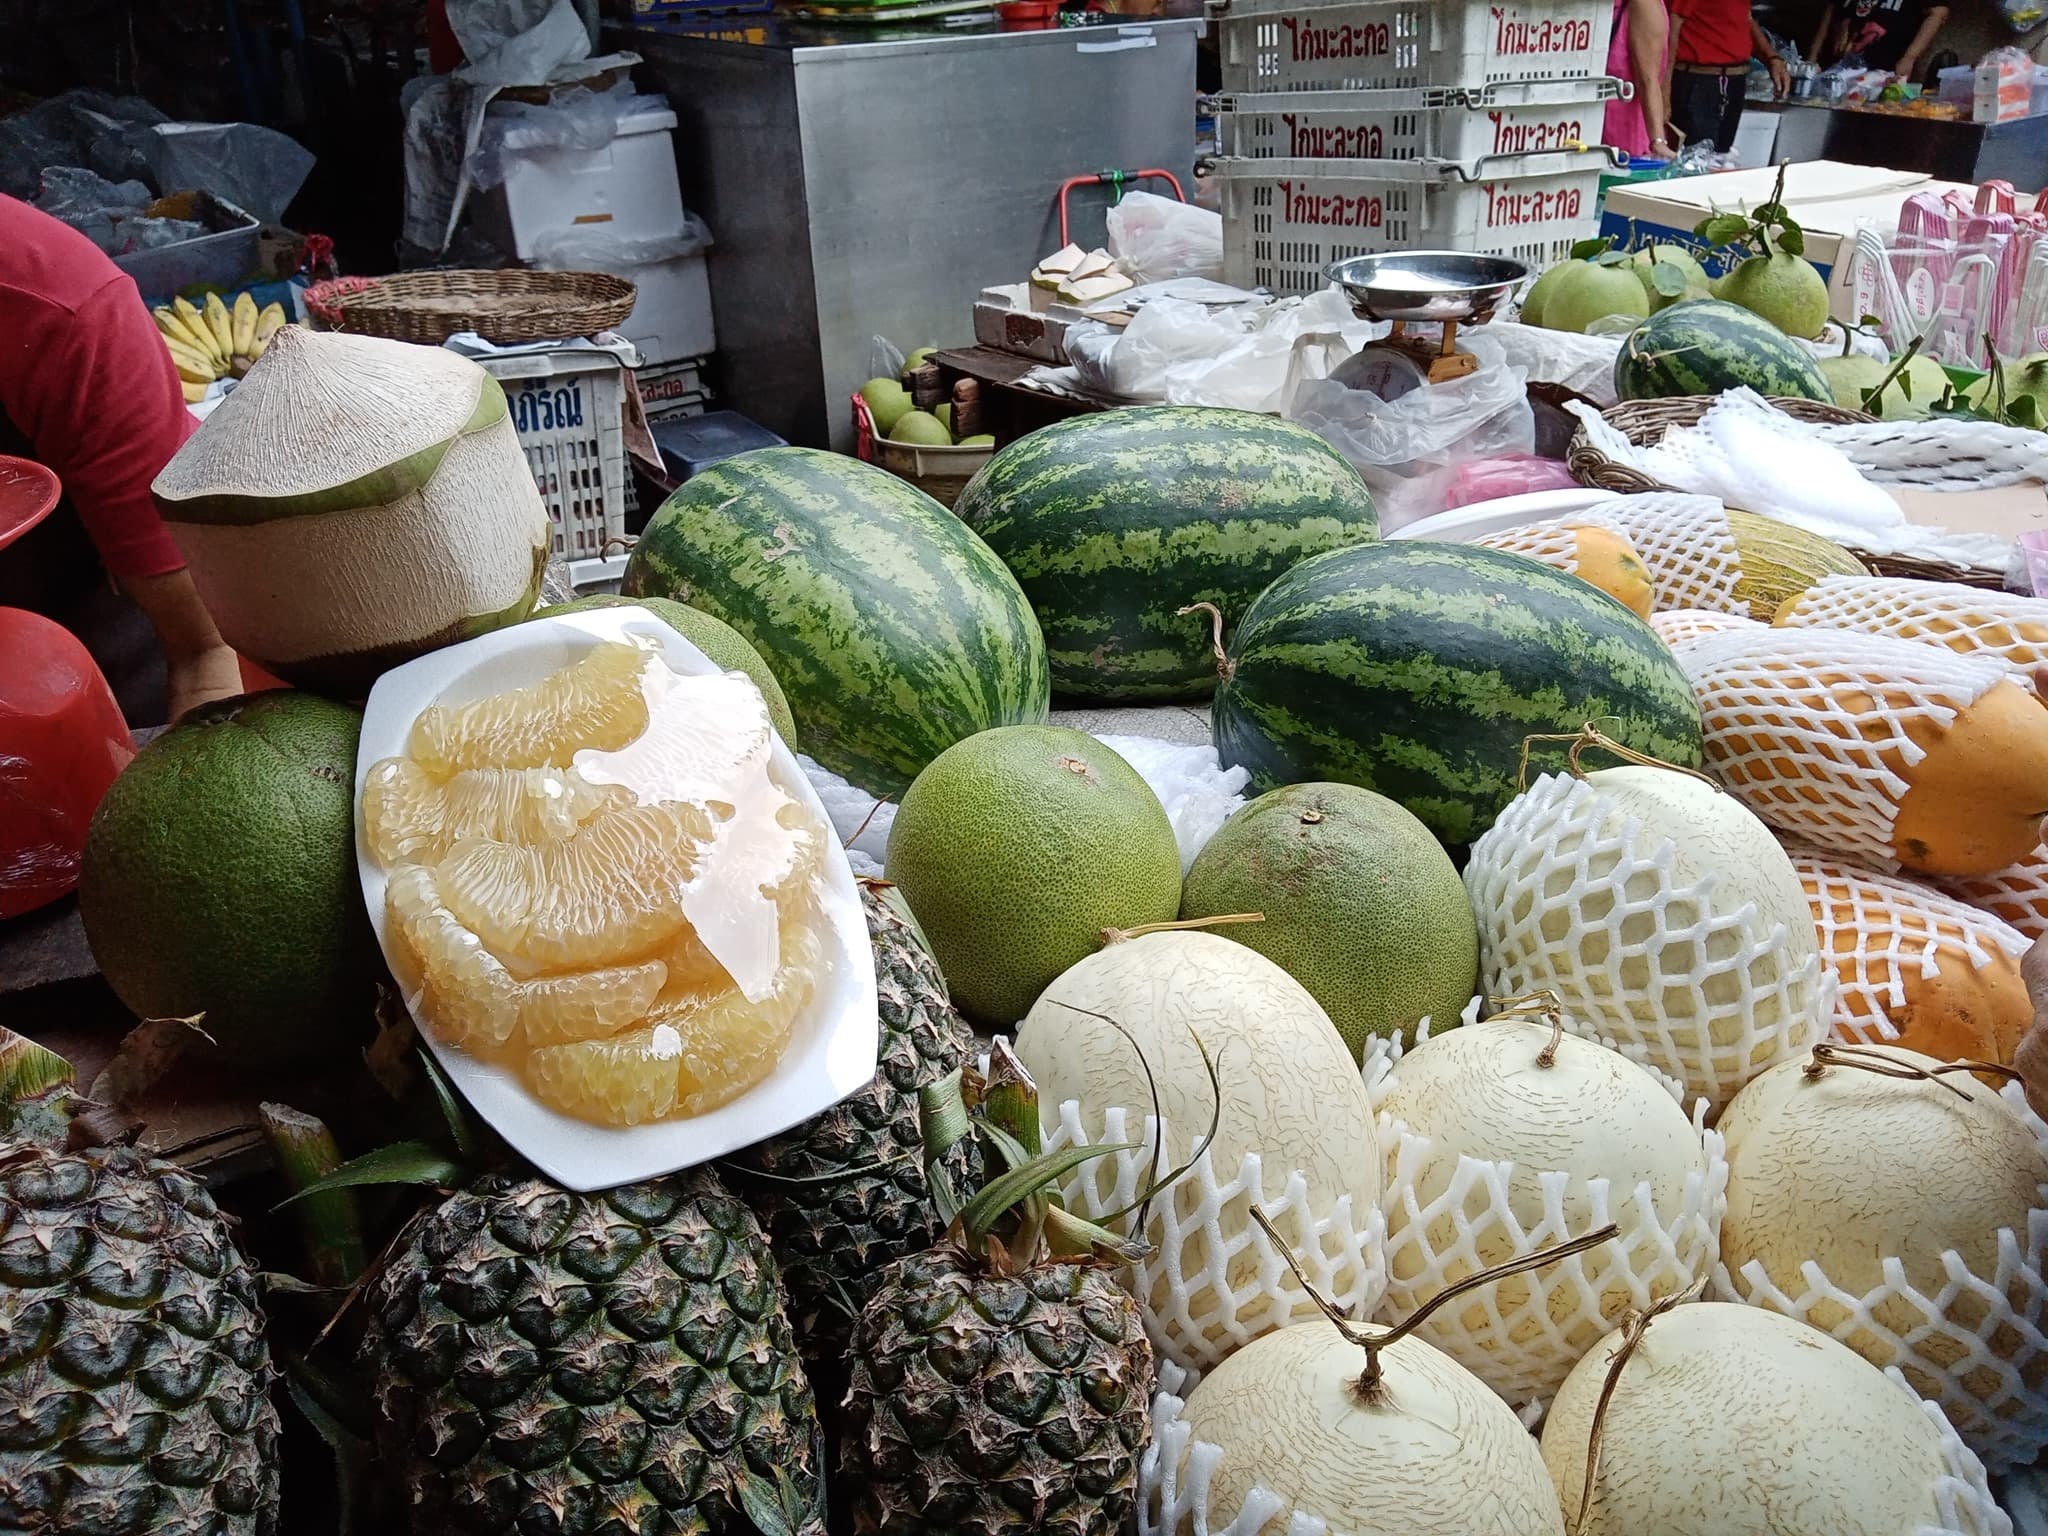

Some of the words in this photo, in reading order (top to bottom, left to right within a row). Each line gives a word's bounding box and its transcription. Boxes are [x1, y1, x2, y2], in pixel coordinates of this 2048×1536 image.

[1284, 17, 1389, 61] ไก่มะละกอ
[1492, 8, 1591, 56] ไก่มะละกอ
[1281, 182, 1383, 228] ไก่มะละกอ
[1486, 184, 1581, 228] ไก่มะละกอ
